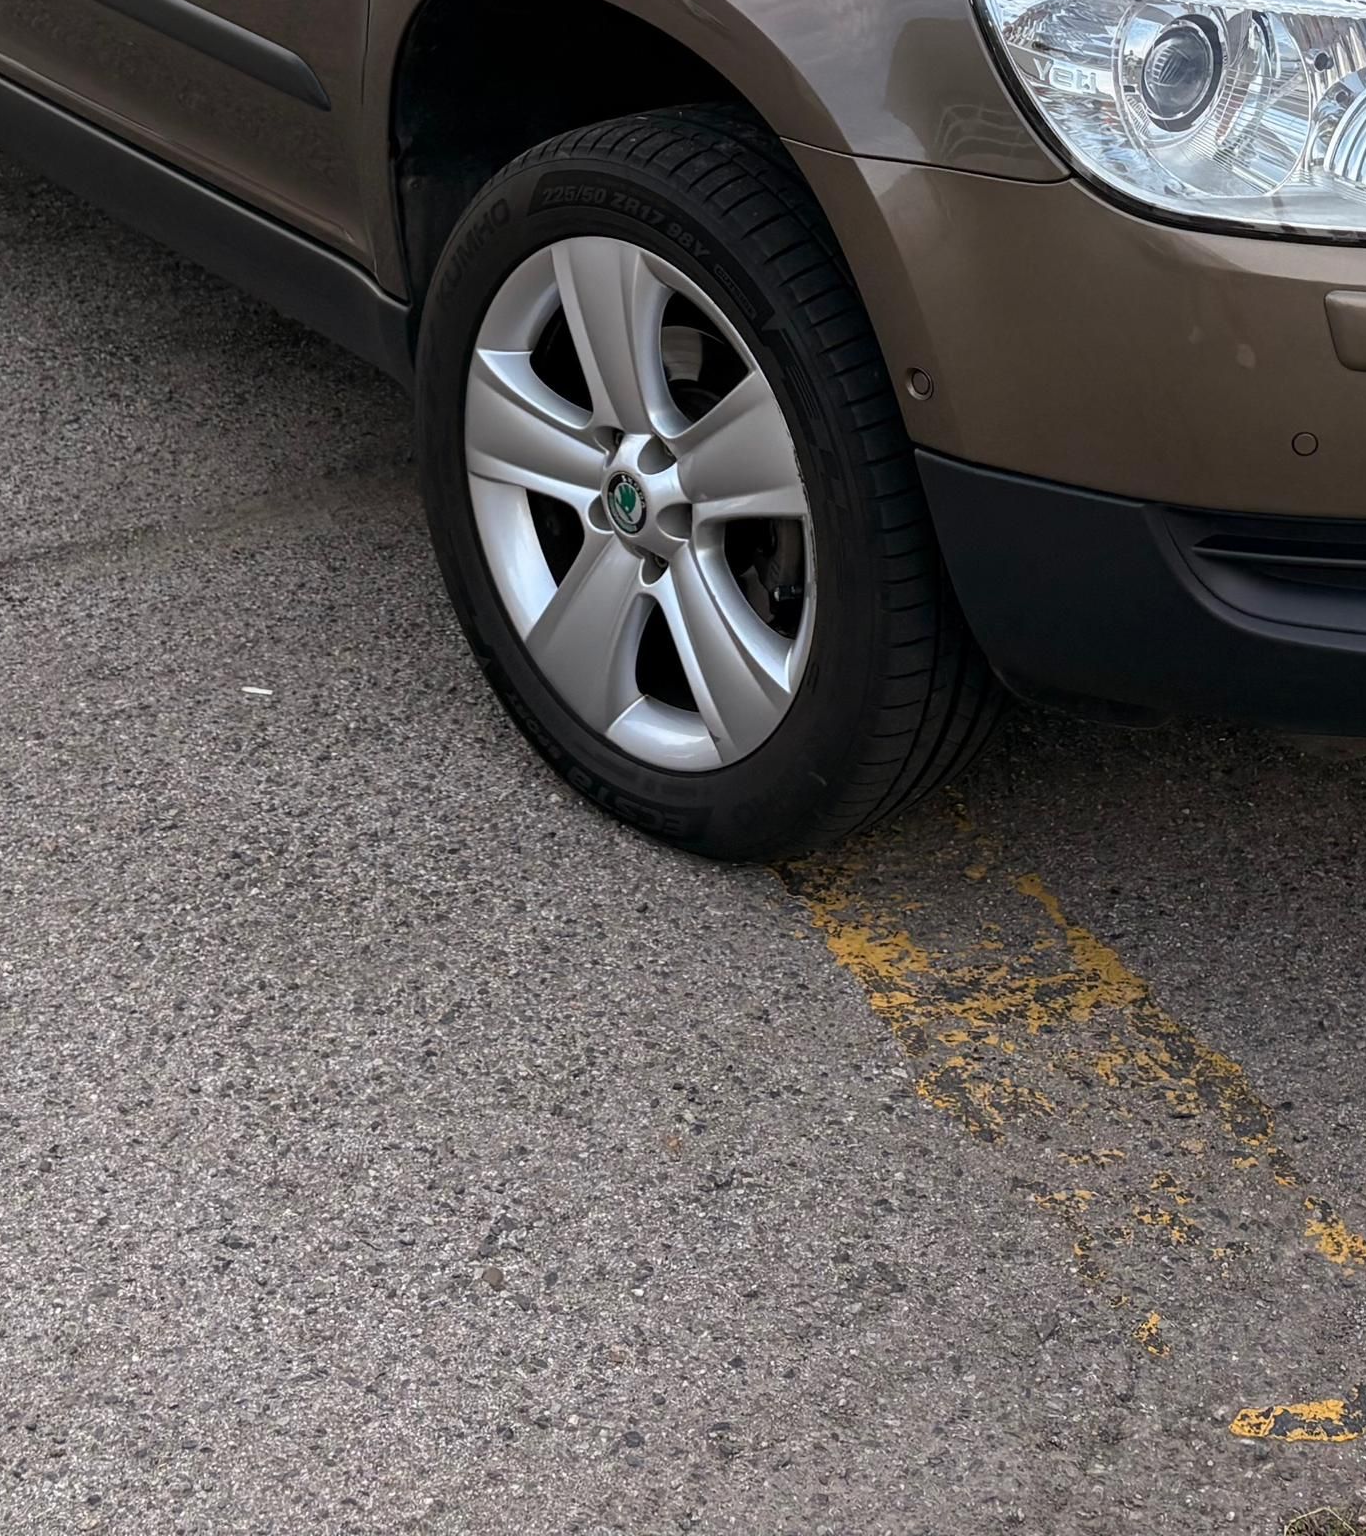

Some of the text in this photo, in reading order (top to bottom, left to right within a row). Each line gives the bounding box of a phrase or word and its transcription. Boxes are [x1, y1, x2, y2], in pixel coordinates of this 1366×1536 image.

[1033, 58, 1096, 94] Yeti
[541, 184, 711, 260] 225/50 ZR17 98Y
